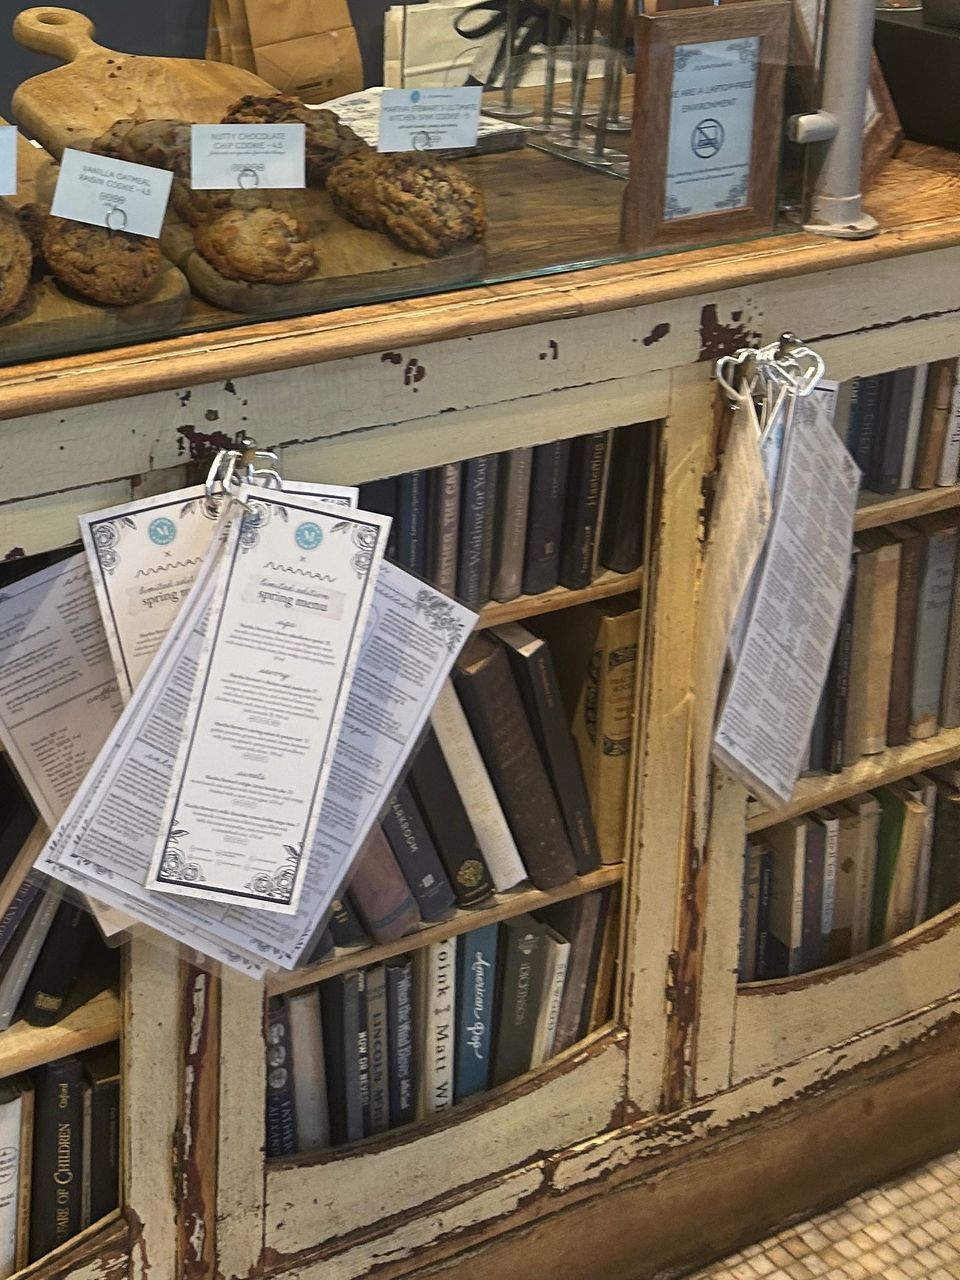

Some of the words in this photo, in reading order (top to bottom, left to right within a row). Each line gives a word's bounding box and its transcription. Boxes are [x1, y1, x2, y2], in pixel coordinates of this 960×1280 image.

[213, 142, 234, 150] CHIP
[235, 141, 266, 150] COOKIE
[238, 132, 287, 141] CHOCOLATE
[105, 179, 135, 193] COOKIE
[472, 488, 486, 511] for
[469, 510, 486, 567] Waiting
[141, 590, 180, 609] spring
[257, 590, 294, 608] spring
[295, 598, 328, 612] menu
[396, 974, 412, 1005] When
[472, 951, 491, 1021] American
[358, 1031, 368, 1054] NOW
[372, 1012, 384, 1084] LINCOLN
[435, 1022, 450, 1074] Matt
[467, 1021, 485, 1060] Pop
[358, 1057, 369, 1070] OR
[58, 1082, 71, 1109] Oxford
[53, 1122, 74, 1185] CHILDREN
[56, 1188, 70, 1205] OF
